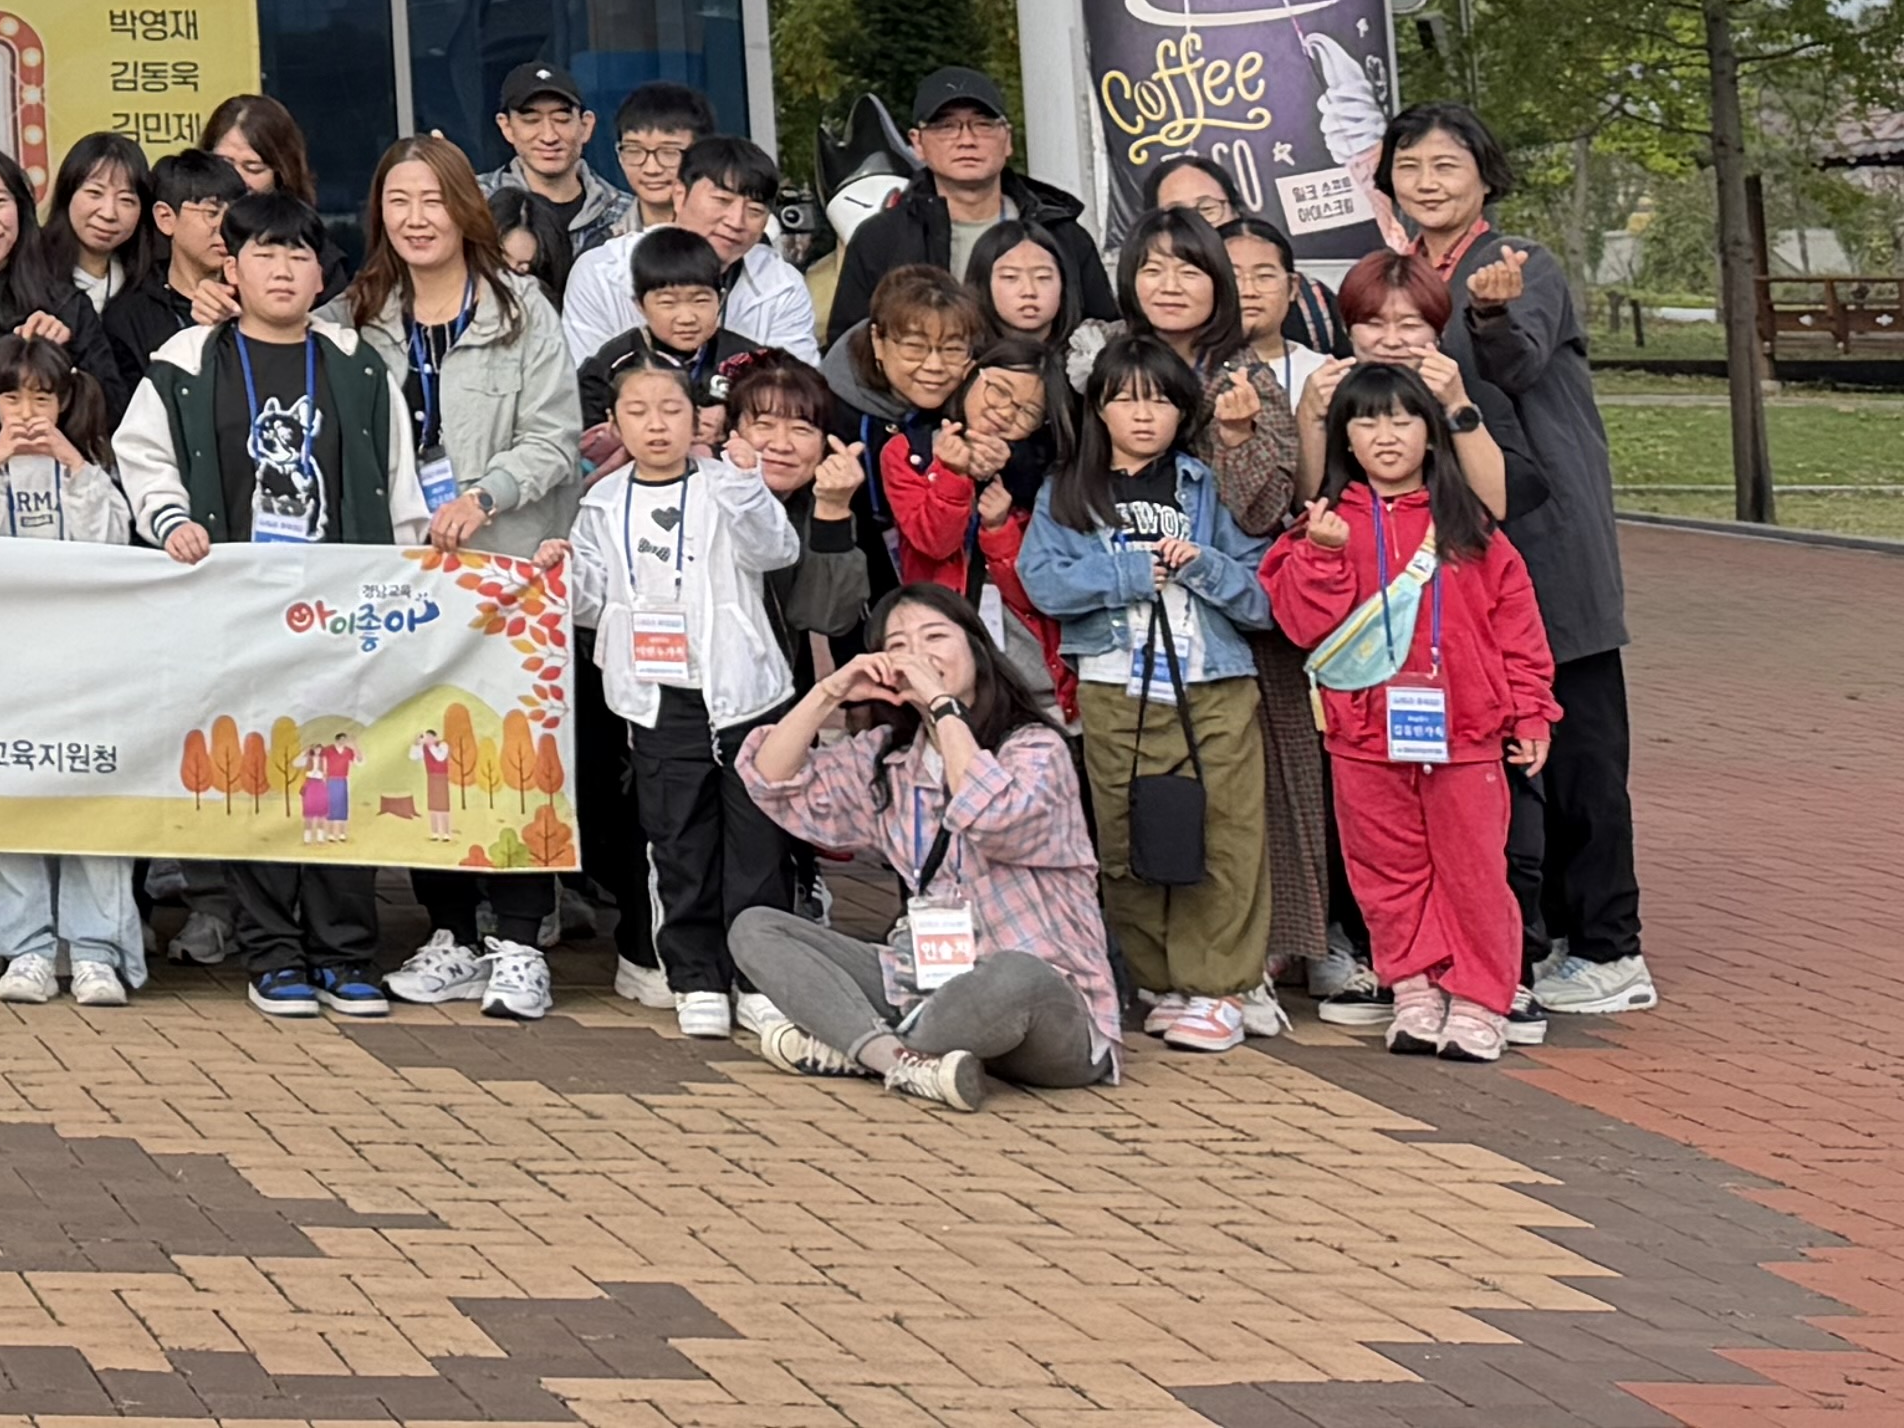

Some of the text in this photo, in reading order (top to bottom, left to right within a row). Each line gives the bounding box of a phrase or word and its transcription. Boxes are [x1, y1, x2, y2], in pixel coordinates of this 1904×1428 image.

[109, 9, 199, 41] 박영재
[111, 61, 200, 93] 김동욱
[1101, 32, 1265, 147] Coffee
